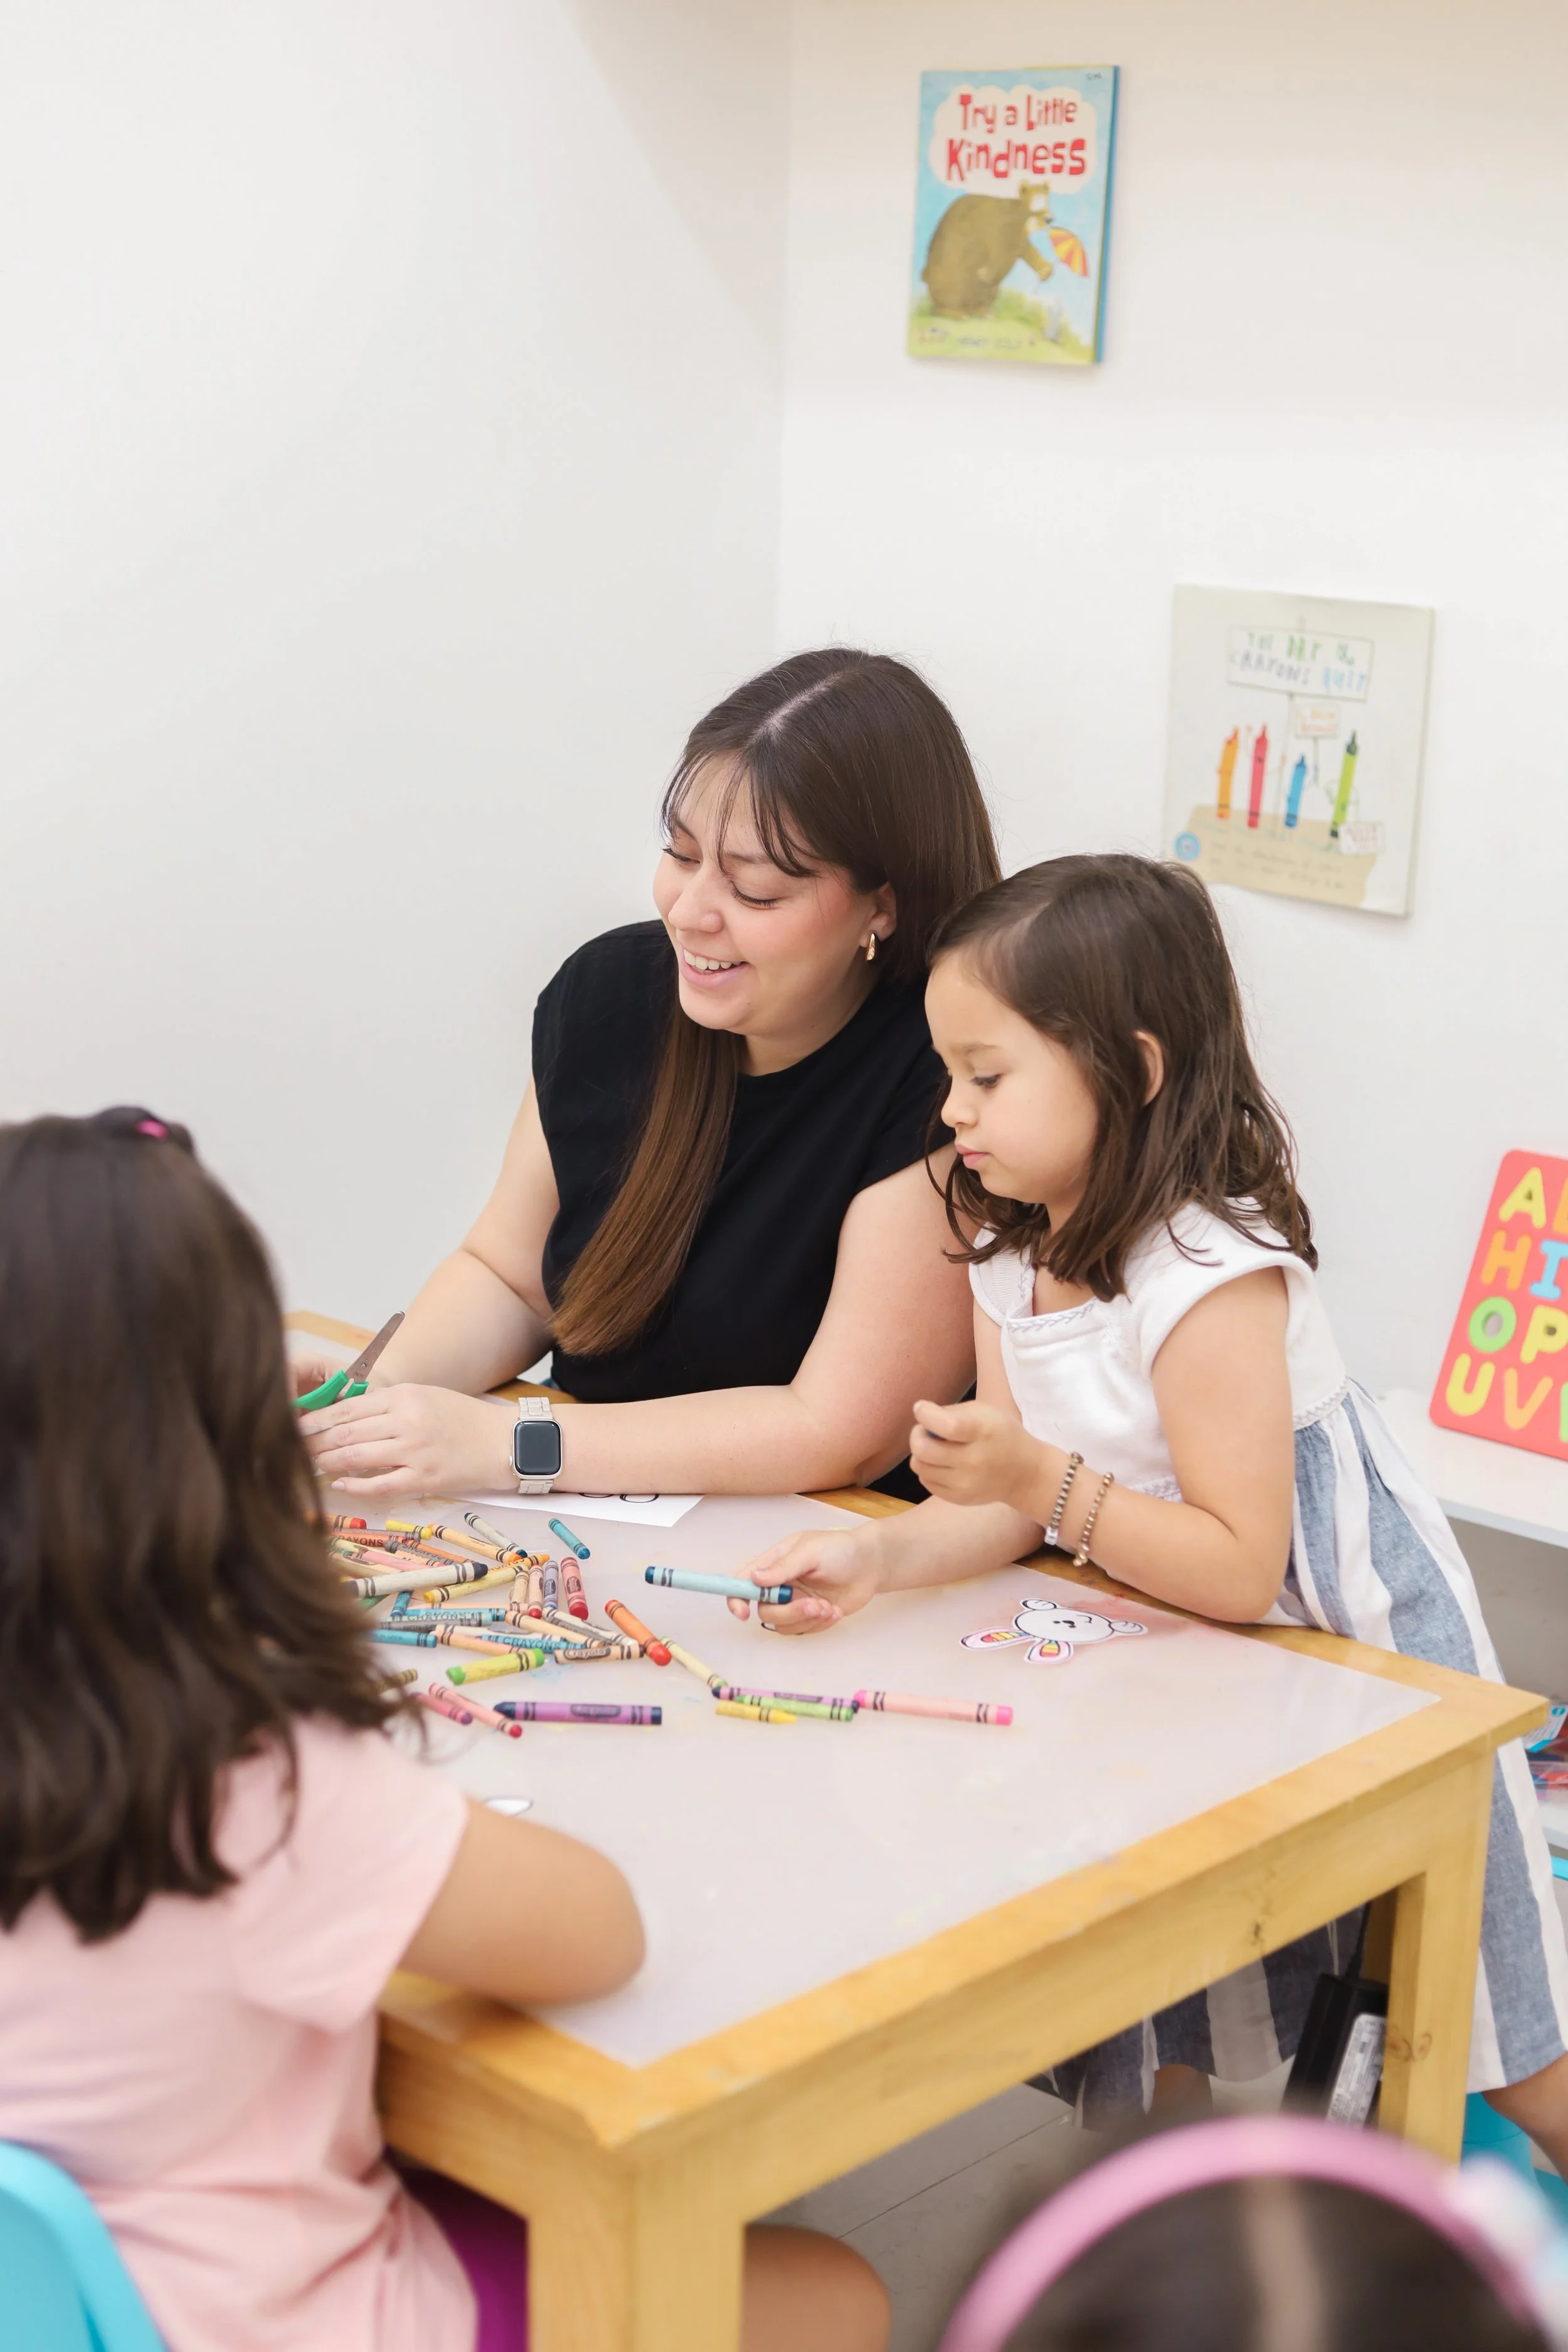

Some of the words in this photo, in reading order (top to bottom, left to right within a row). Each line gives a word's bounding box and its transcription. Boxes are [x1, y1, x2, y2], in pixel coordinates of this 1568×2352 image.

[960, 93, 997, 134] Try
[1005, 105, 1018, 125] a
[1027, 93, 1078, 131] Little
[947, 137, 1087, 182] Kindness
[1498, 1167, 1546, 1229] A
[1481, 1229, 1532, 1291] H
[1468, 1295, 1517, 1353] O
[1446, 1353, 1496, 1417] U
[1504, 1367, 1554, 1431] V
[336, 1534, 384, 1547] RAYONS
[502, 1636, 561, 1651] CRAYONS
